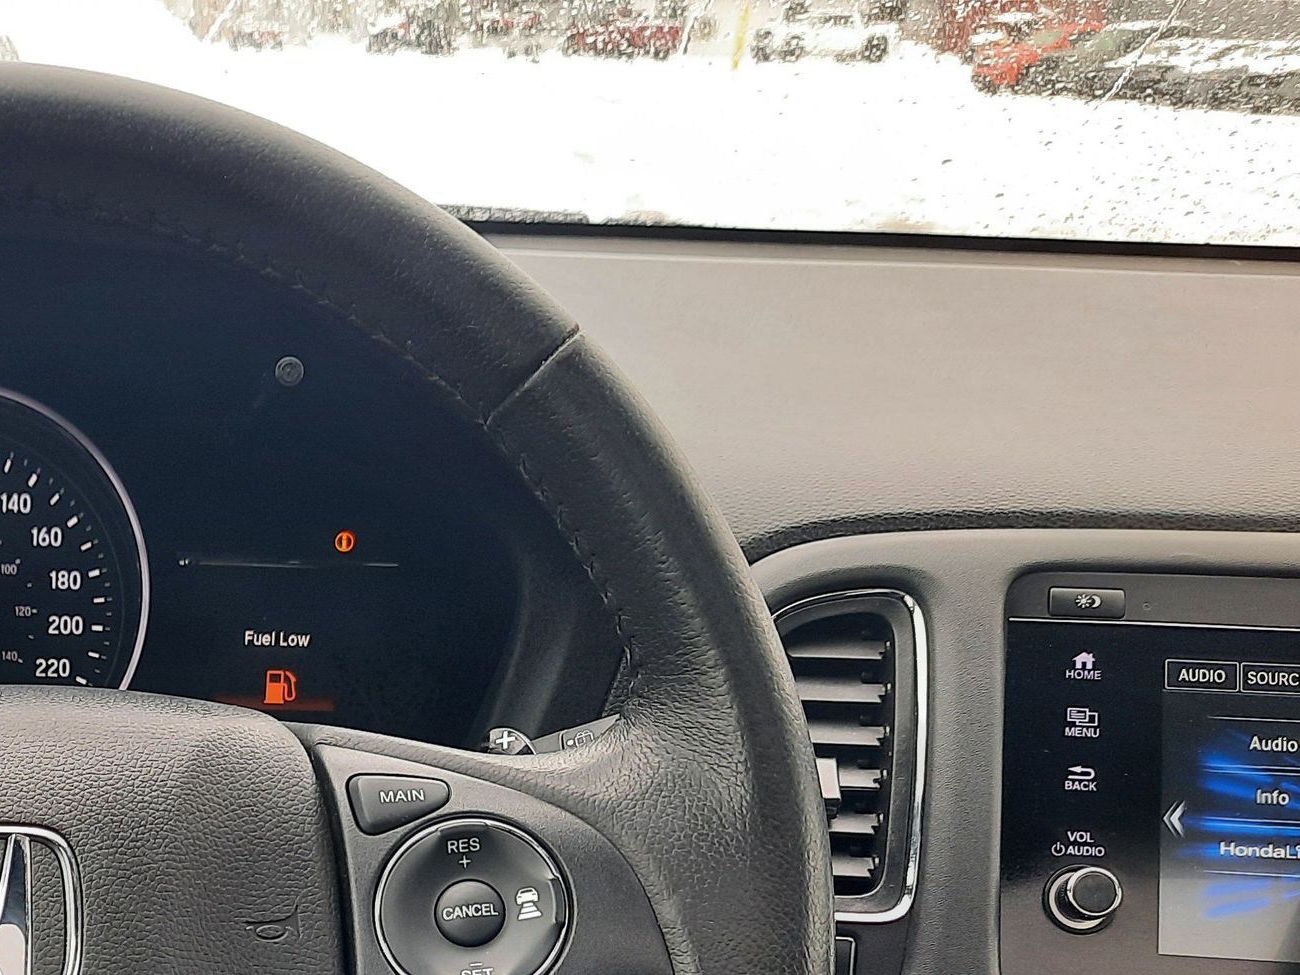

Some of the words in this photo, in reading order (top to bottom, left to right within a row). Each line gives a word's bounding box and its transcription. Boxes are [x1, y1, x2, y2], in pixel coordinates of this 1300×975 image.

[0, 492, 31, 514] 140
[31, 526, 62, 547] 160
[0, 563, 17, 575] 100
[49, 570, 81, 590] 180
[14, 605, 31, 617] 120
[48, 615, 83, 635] 200
[244, 630, 276, 646] Fuel
[279, 631, 310, 647] Low
[1, 650, 18, 662] 140
[35, 658, 70, 678] 220
[1065, 669, 1102, 680] HOME
[1178, 668, 1226, 683] AUDIO
[1064, 726, 1100, 738] MENU
[1249, 735, 1298, 752] Audio
[1063, 780, 1098, 792] BACK
[379, 788, 425, 803] MAIN
[1255, 789, 1290, 804] Info
[1067, 831, 1094, 843] VOL
[447, 837, 481, 853] RES
[1066, 845, 1105, 857] AUDIO
[442, 903, 499, 921] CANCEL
